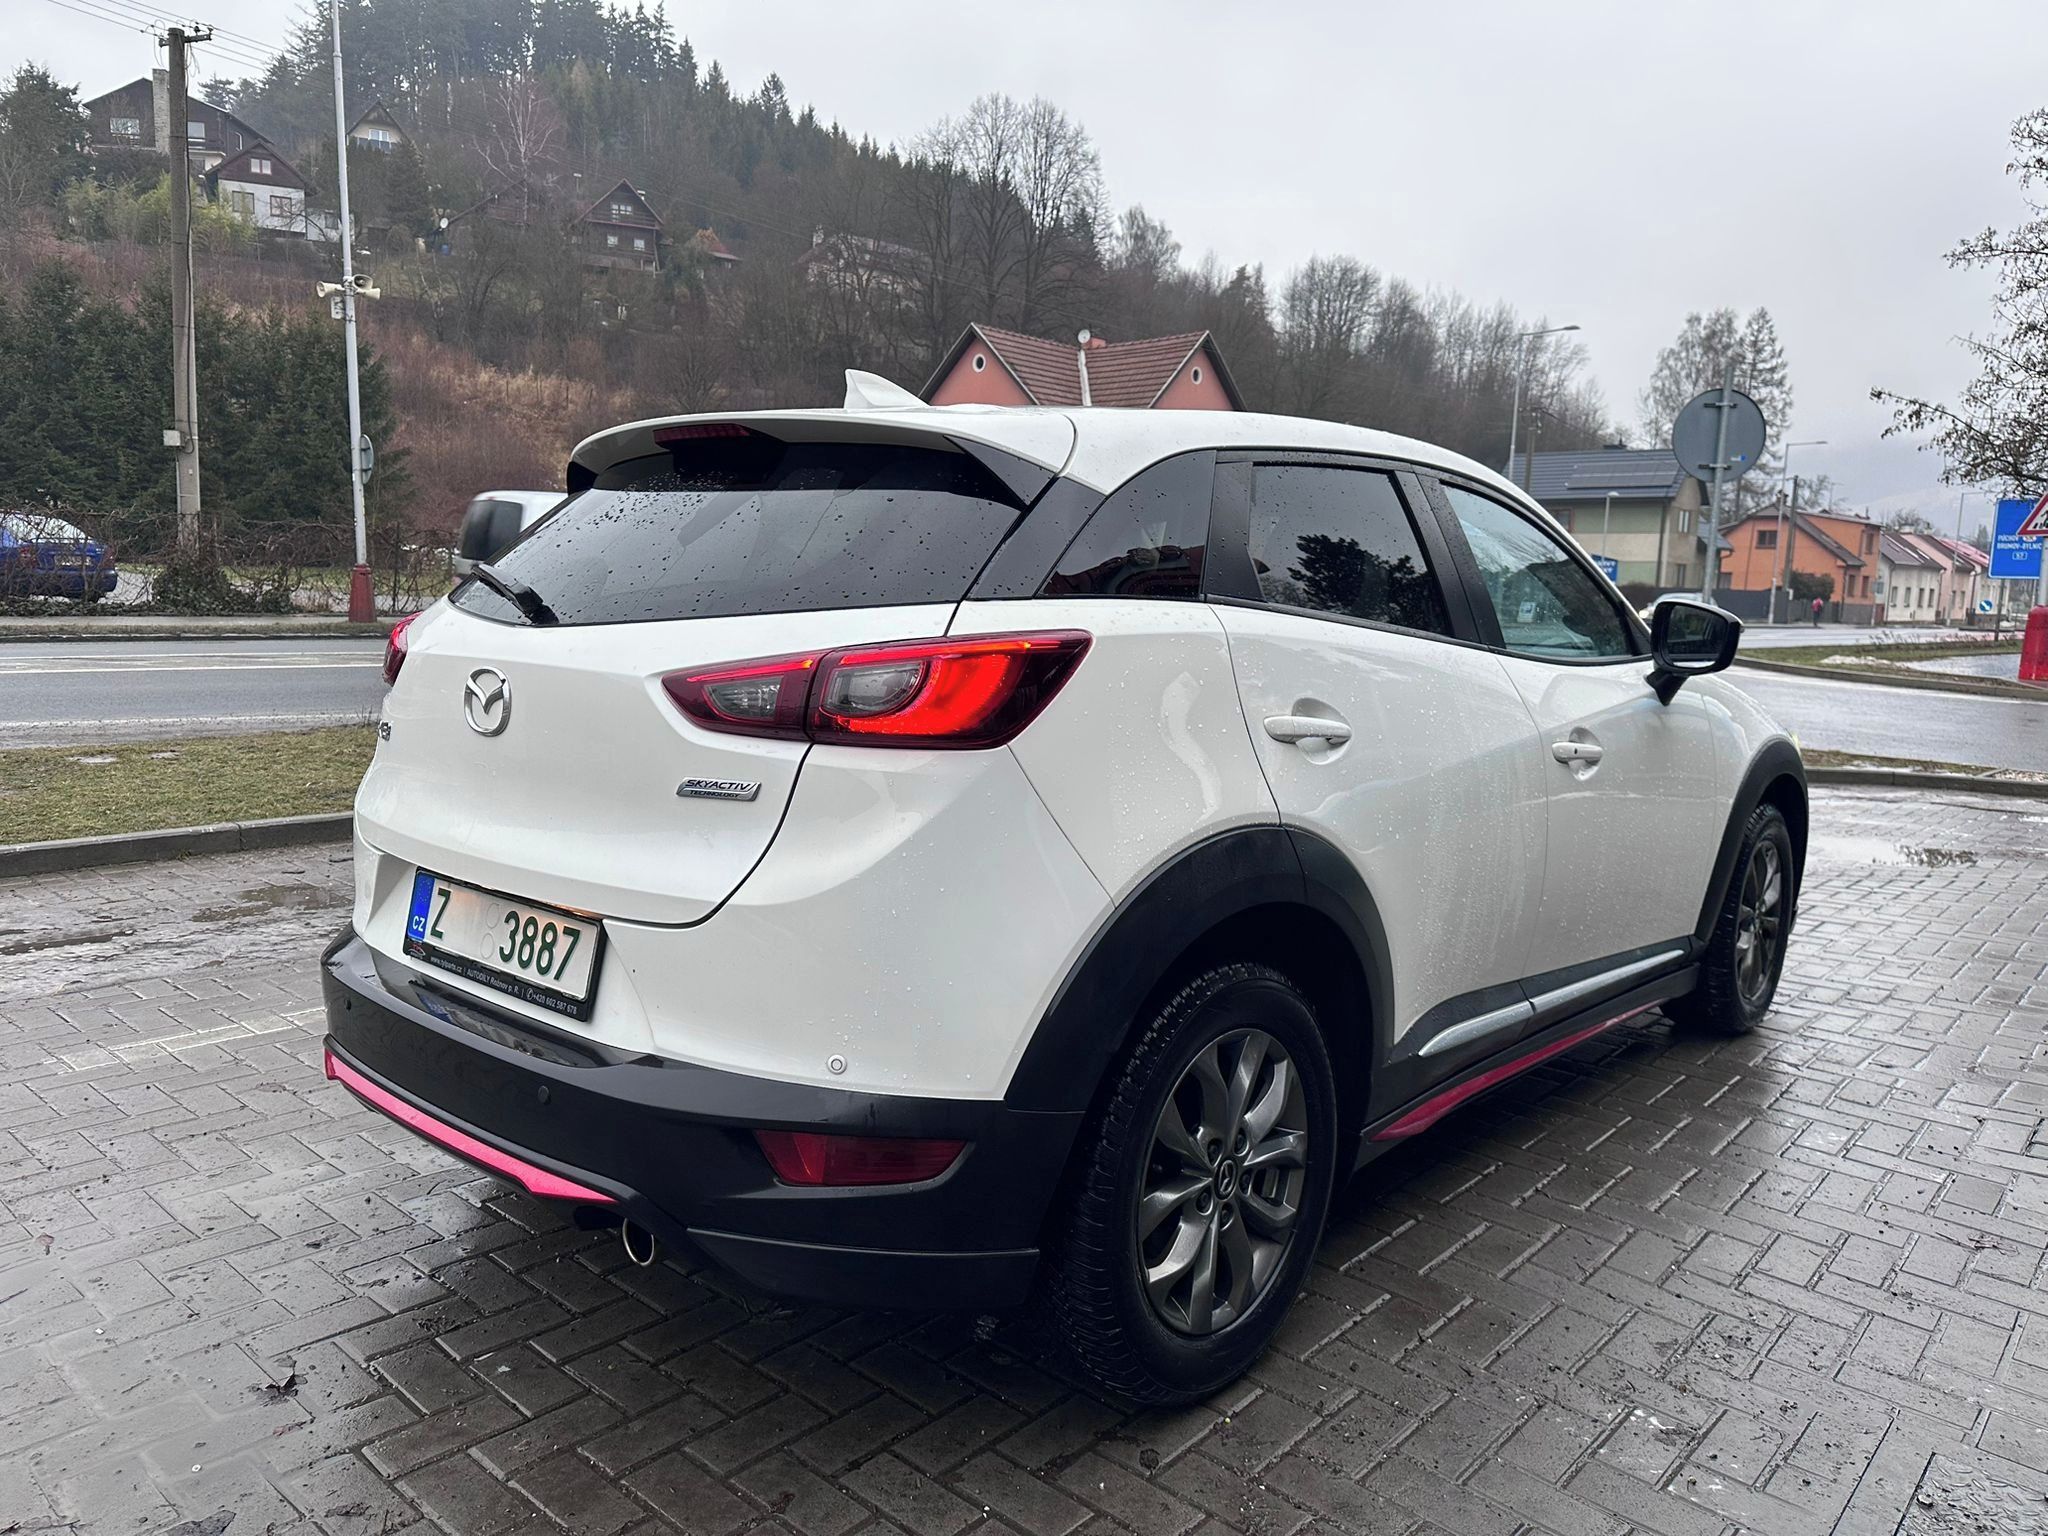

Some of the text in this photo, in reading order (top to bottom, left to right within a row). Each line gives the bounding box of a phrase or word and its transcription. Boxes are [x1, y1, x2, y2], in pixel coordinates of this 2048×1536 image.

[685, 779, 751, 790] SKYACTIV
[690, 790, 740, 798] TECHNOLOGY
[412, 916, 424, 931] CZ
[430, 887, 581, 980] Z 3887
